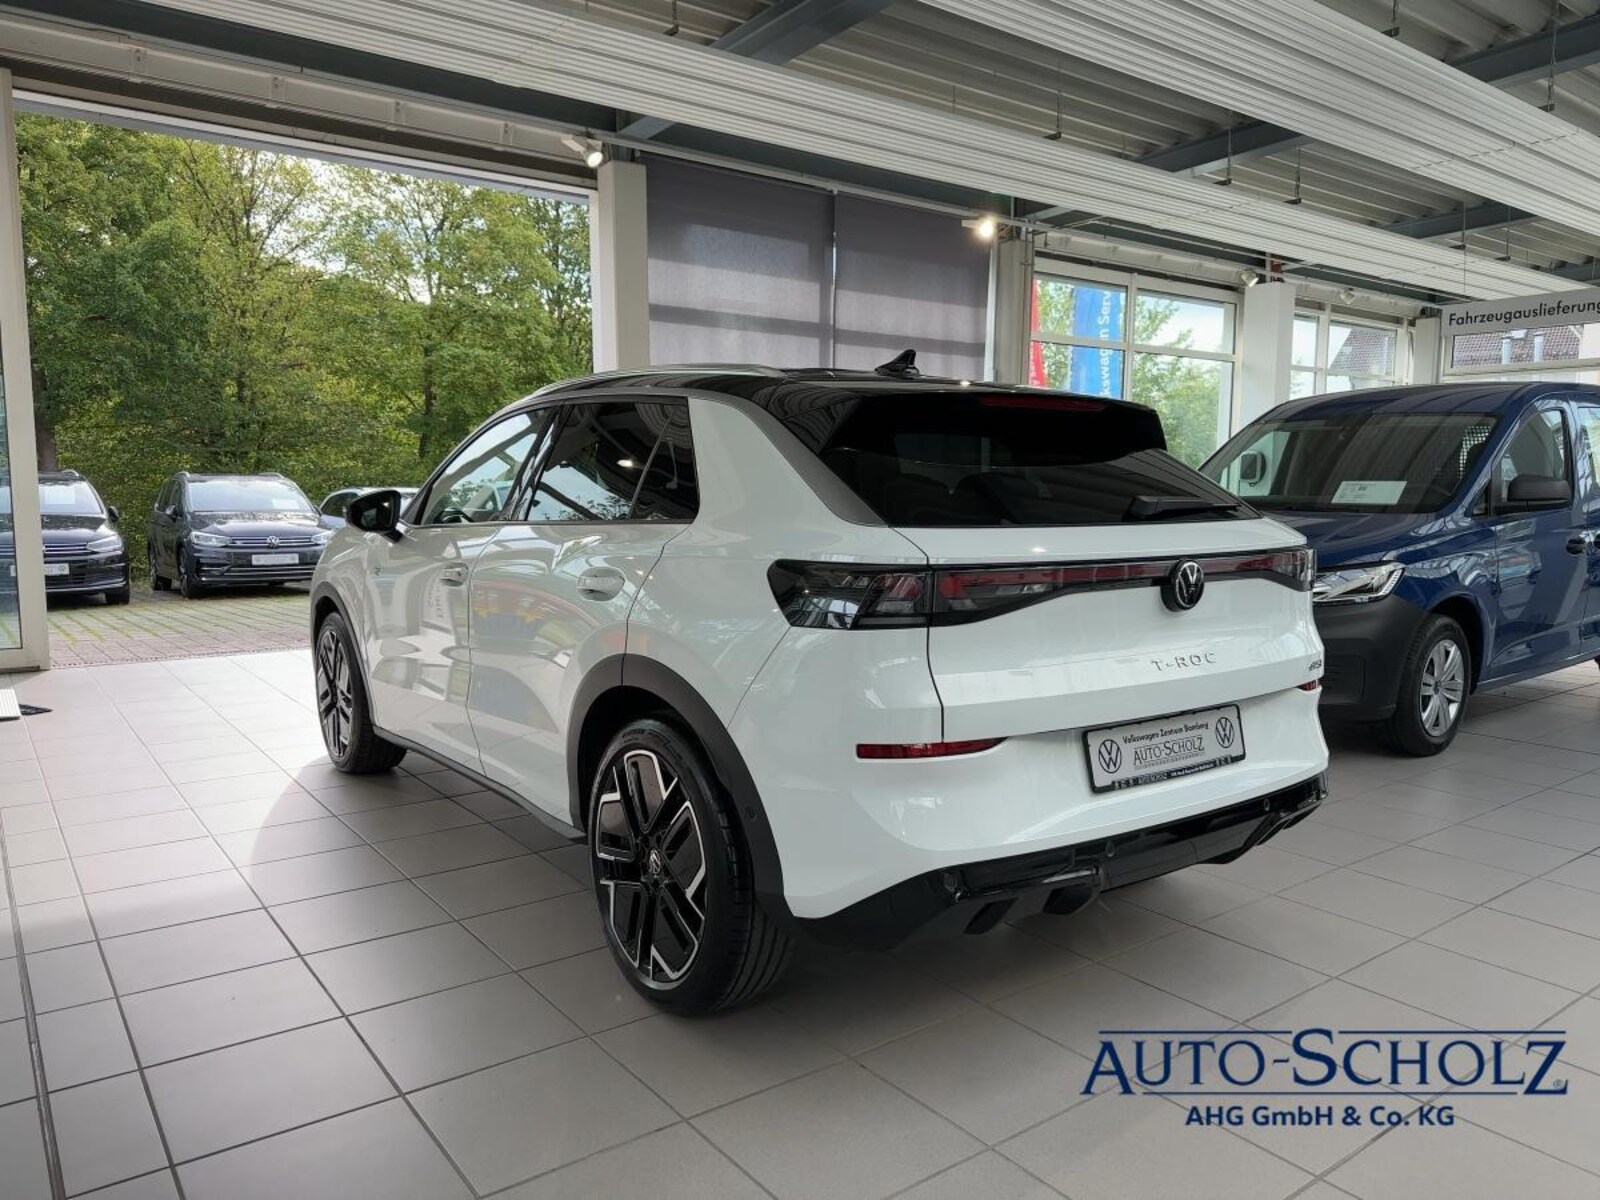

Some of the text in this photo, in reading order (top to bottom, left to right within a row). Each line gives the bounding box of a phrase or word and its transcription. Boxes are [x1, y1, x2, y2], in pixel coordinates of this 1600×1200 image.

[1151, 652, 1217, 672] T-ROC
[1160, 727, 1184, 737] Zentrum
[1134, 737, 1204, 765] AUTO-SCHOLZ
